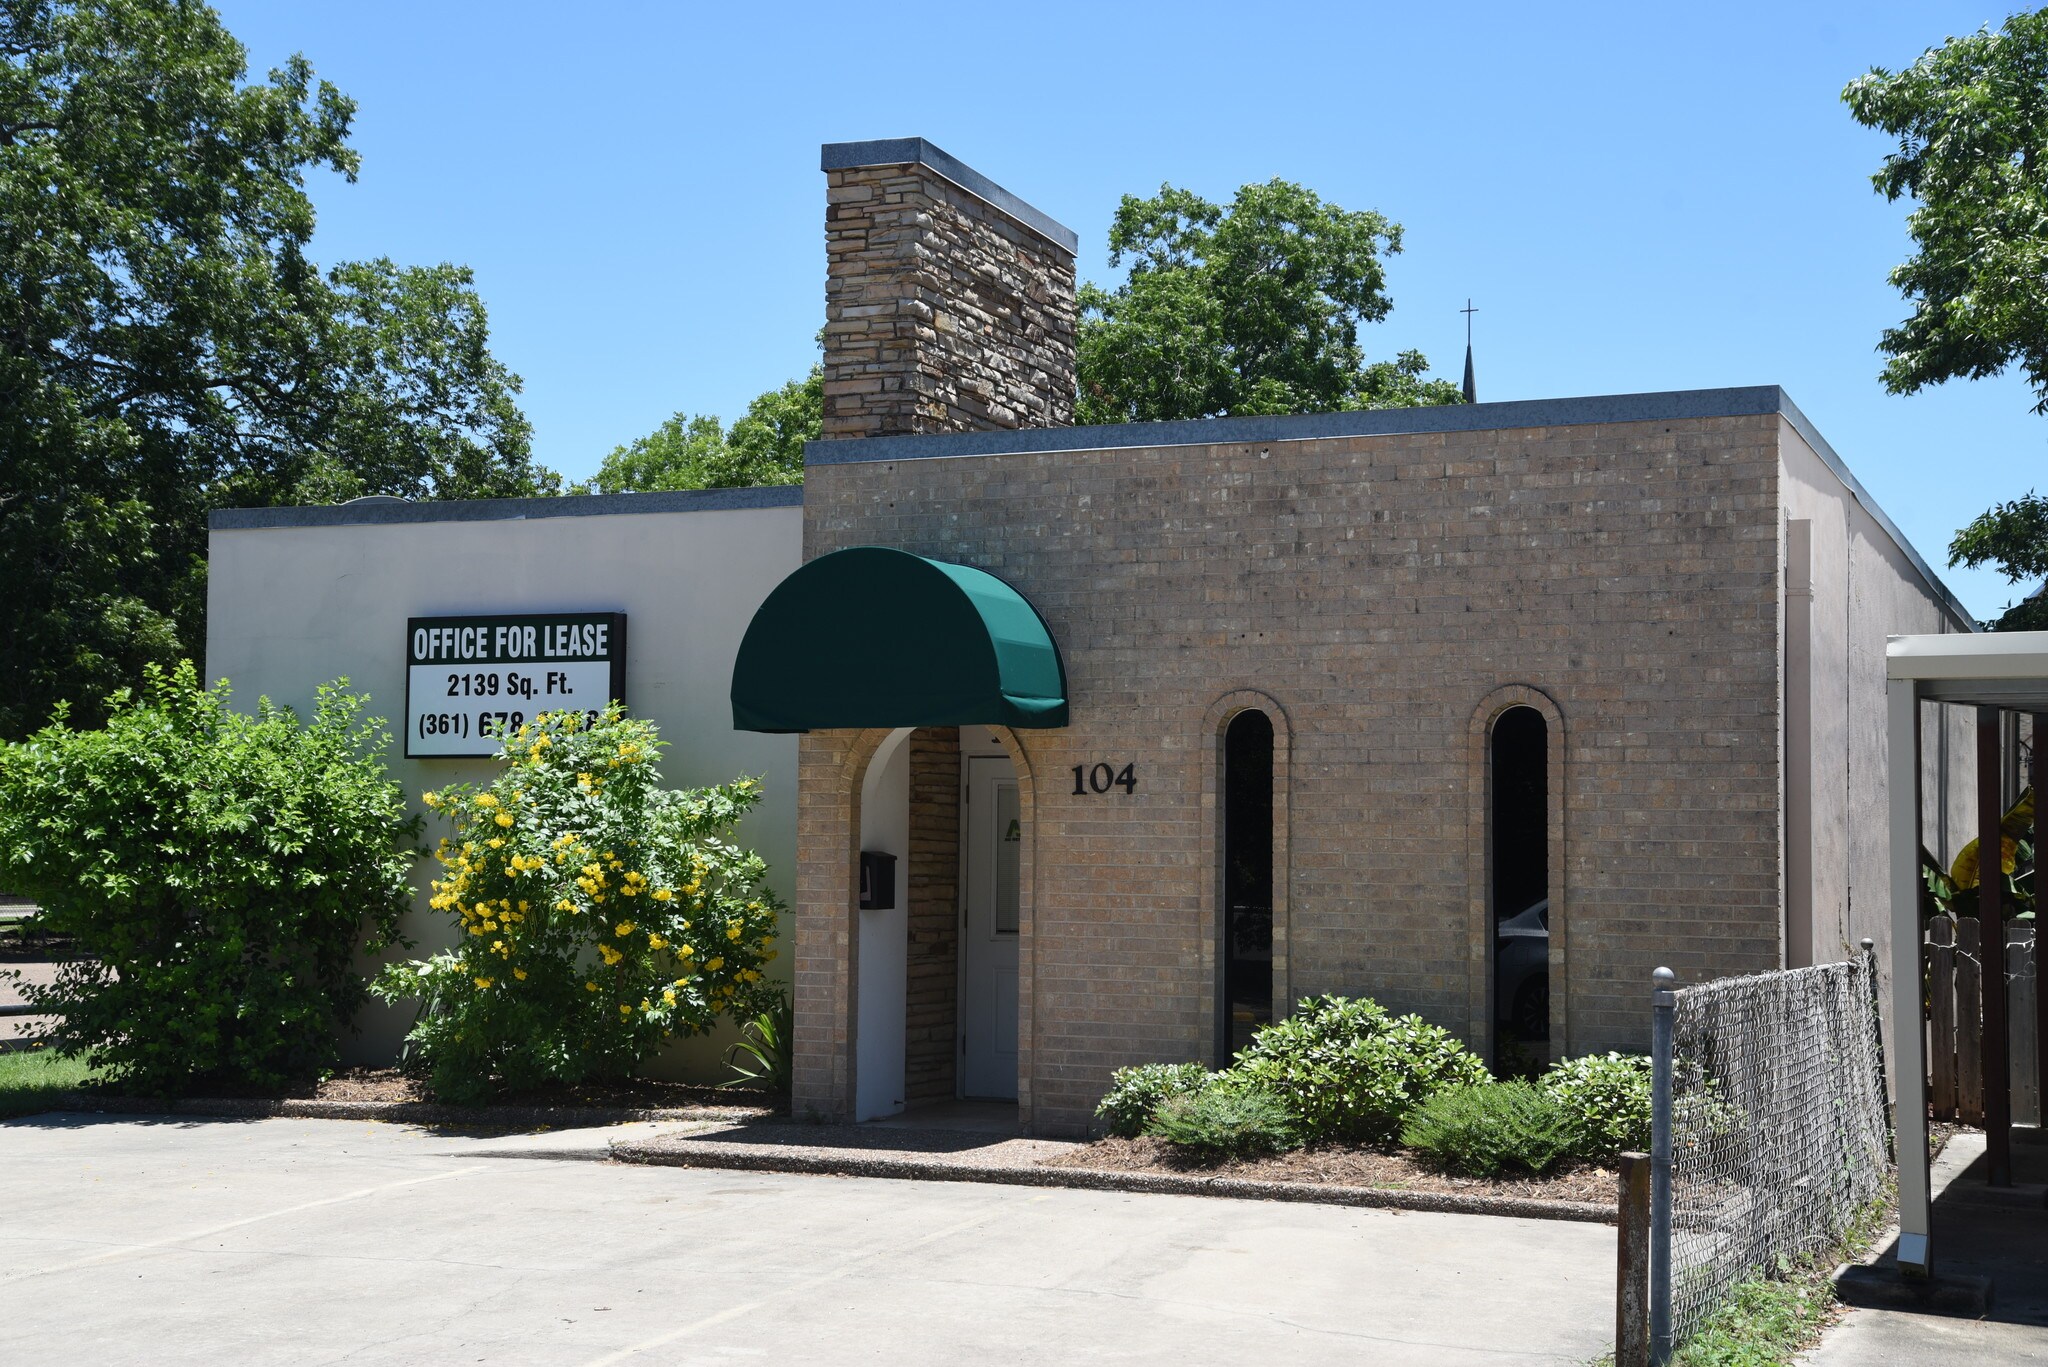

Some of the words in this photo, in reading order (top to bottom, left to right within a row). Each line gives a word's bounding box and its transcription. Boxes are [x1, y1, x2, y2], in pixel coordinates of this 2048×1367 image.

[414, 627, 488, 660] OFFICE
[495, 626, 537, 658] FOR
[544, 624, 608, 656] LEASE
[447, 673, 499, 697] 2139
[506, 672, 538, 700] Sq.
[546, 672, 573, 695] Ft.
[419, 713, 469, 739] (361)
[1071, 762, 1137, 795] 104
